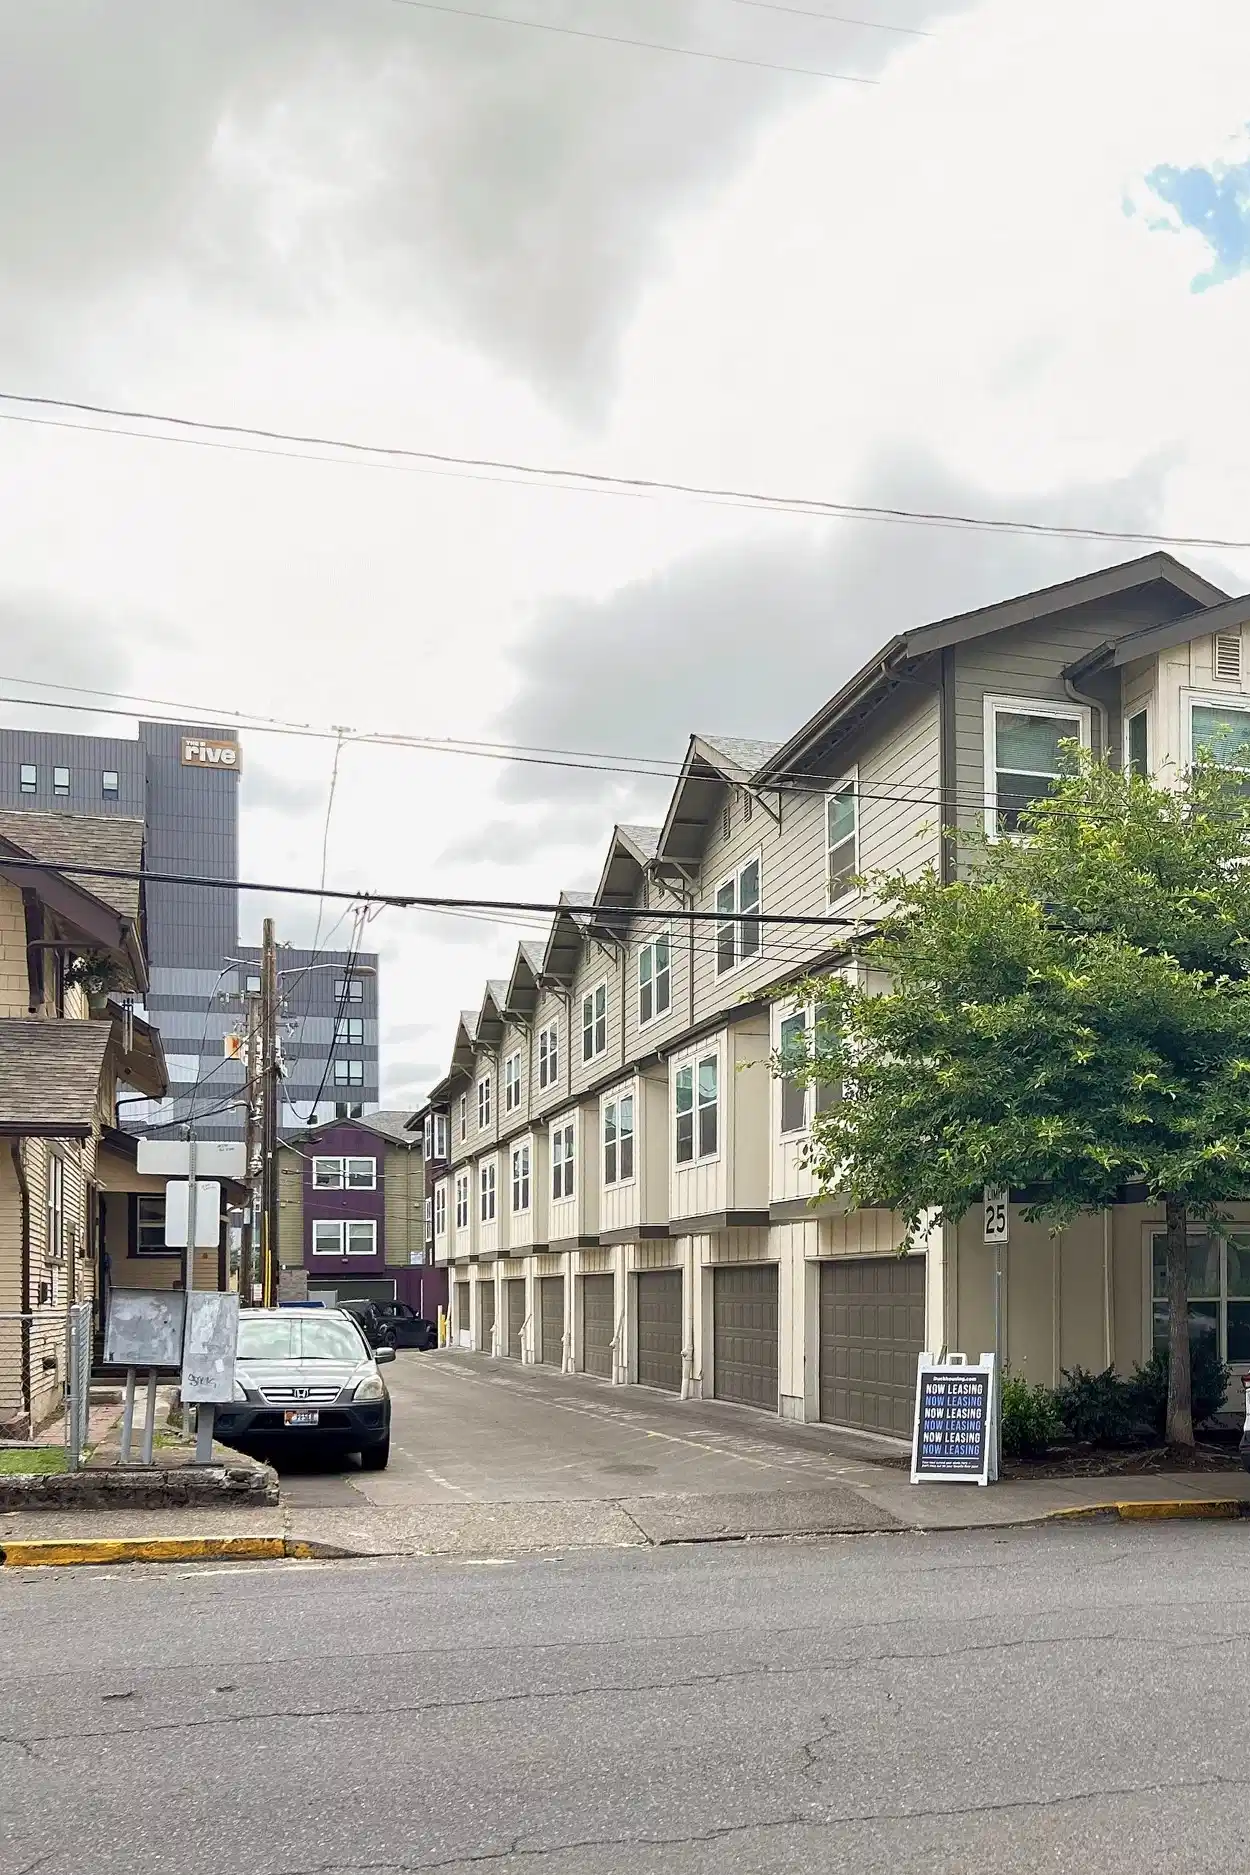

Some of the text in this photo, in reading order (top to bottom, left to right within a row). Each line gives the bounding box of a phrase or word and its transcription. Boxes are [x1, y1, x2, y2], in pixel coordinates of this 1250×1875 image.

[185, 742, 236, 765] rive
[986, 1204, 1005, 1234] 25
[925, 1383, 983, 1395] NOW LEASING
[925, 1395, 982, 1407] NOW LEASING
[924, 1407, 982, 1419] NOW LEASING
[924, 1420, 981, 1431] NOW LEASING
[923, 1432, 980, 1444] NOW LEASING
[922, 1444, 980, 1455] NOW LEASING
